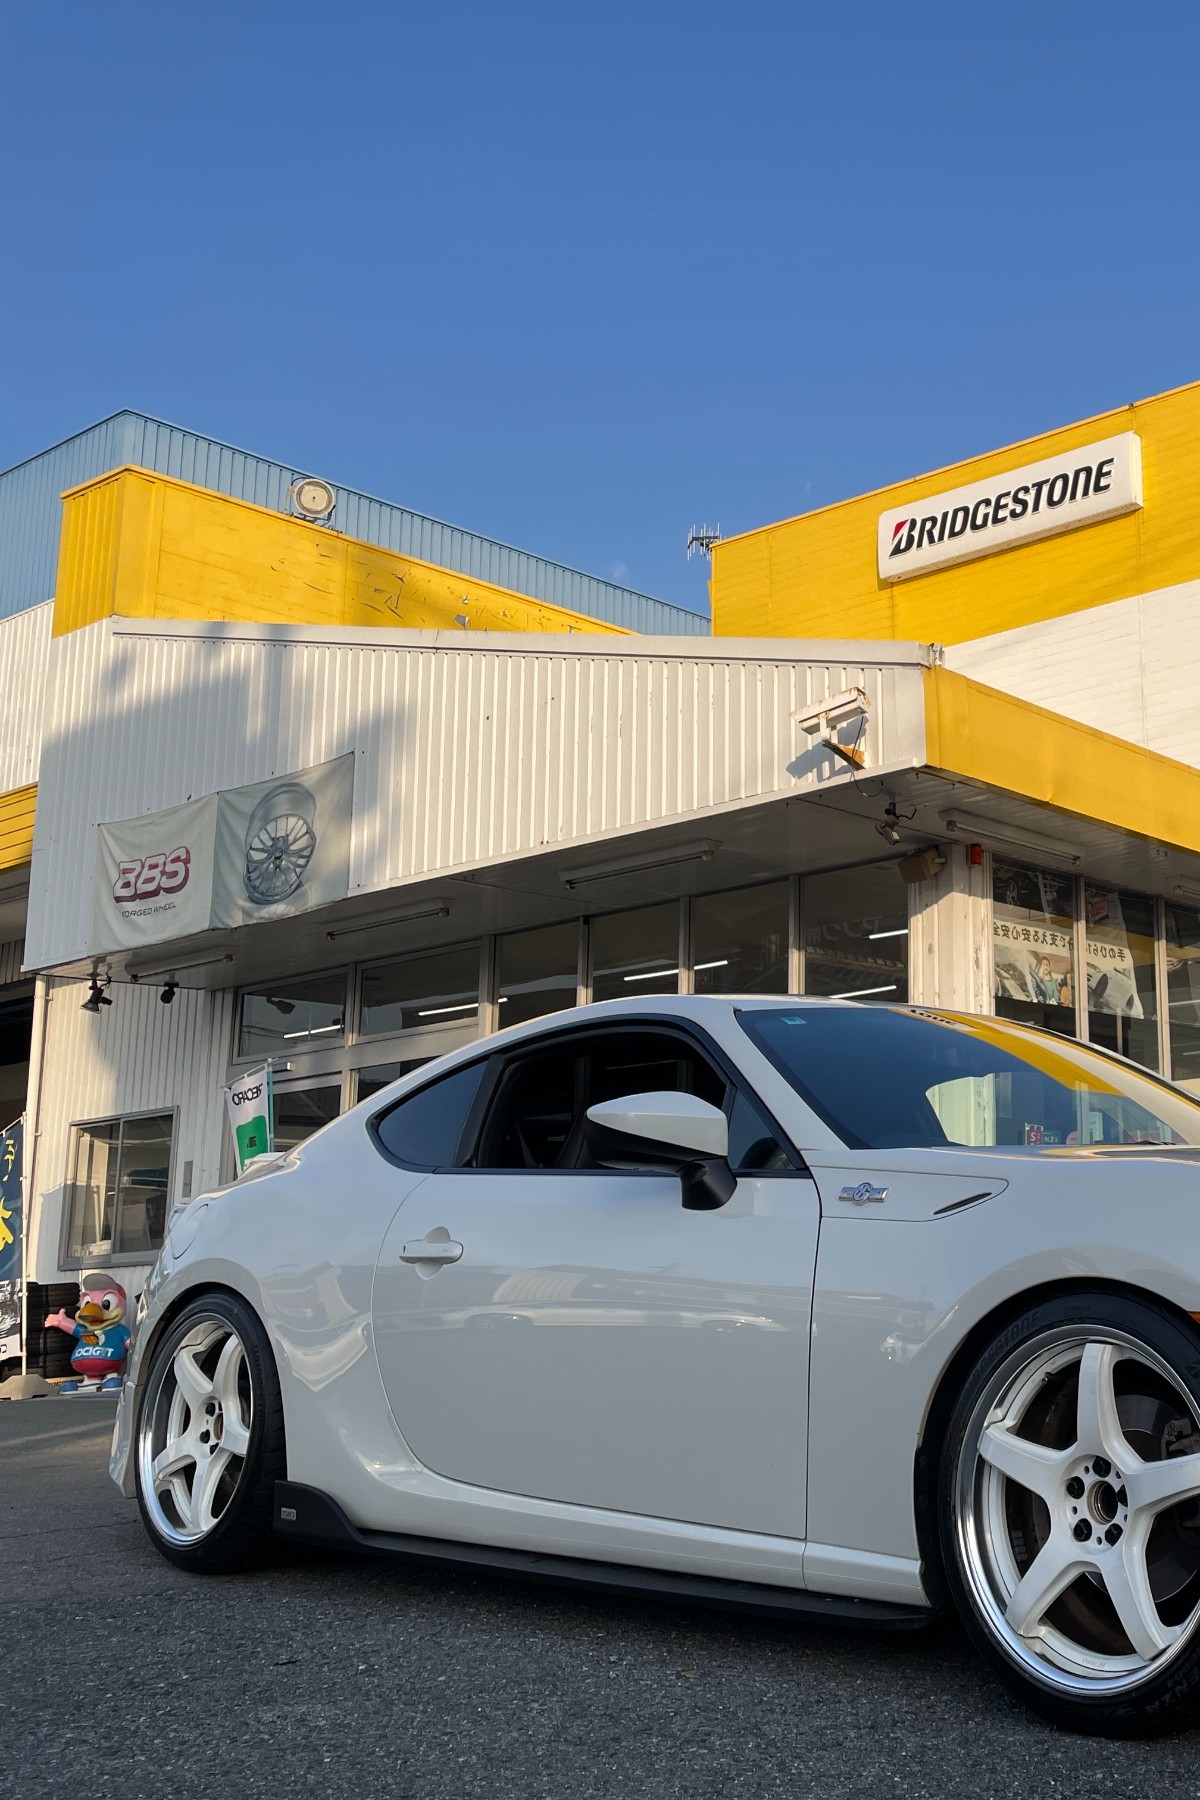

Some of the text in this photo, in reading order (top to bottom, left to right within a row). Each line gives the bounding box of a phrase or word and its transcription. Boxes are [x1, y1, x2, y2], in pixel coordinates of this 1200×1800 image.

[888, 457, 1115, 558] BRIDGESTONE
[113, 846, 191, 903] BBS
[121, 901, 177, 919] FORGED WHEEL
